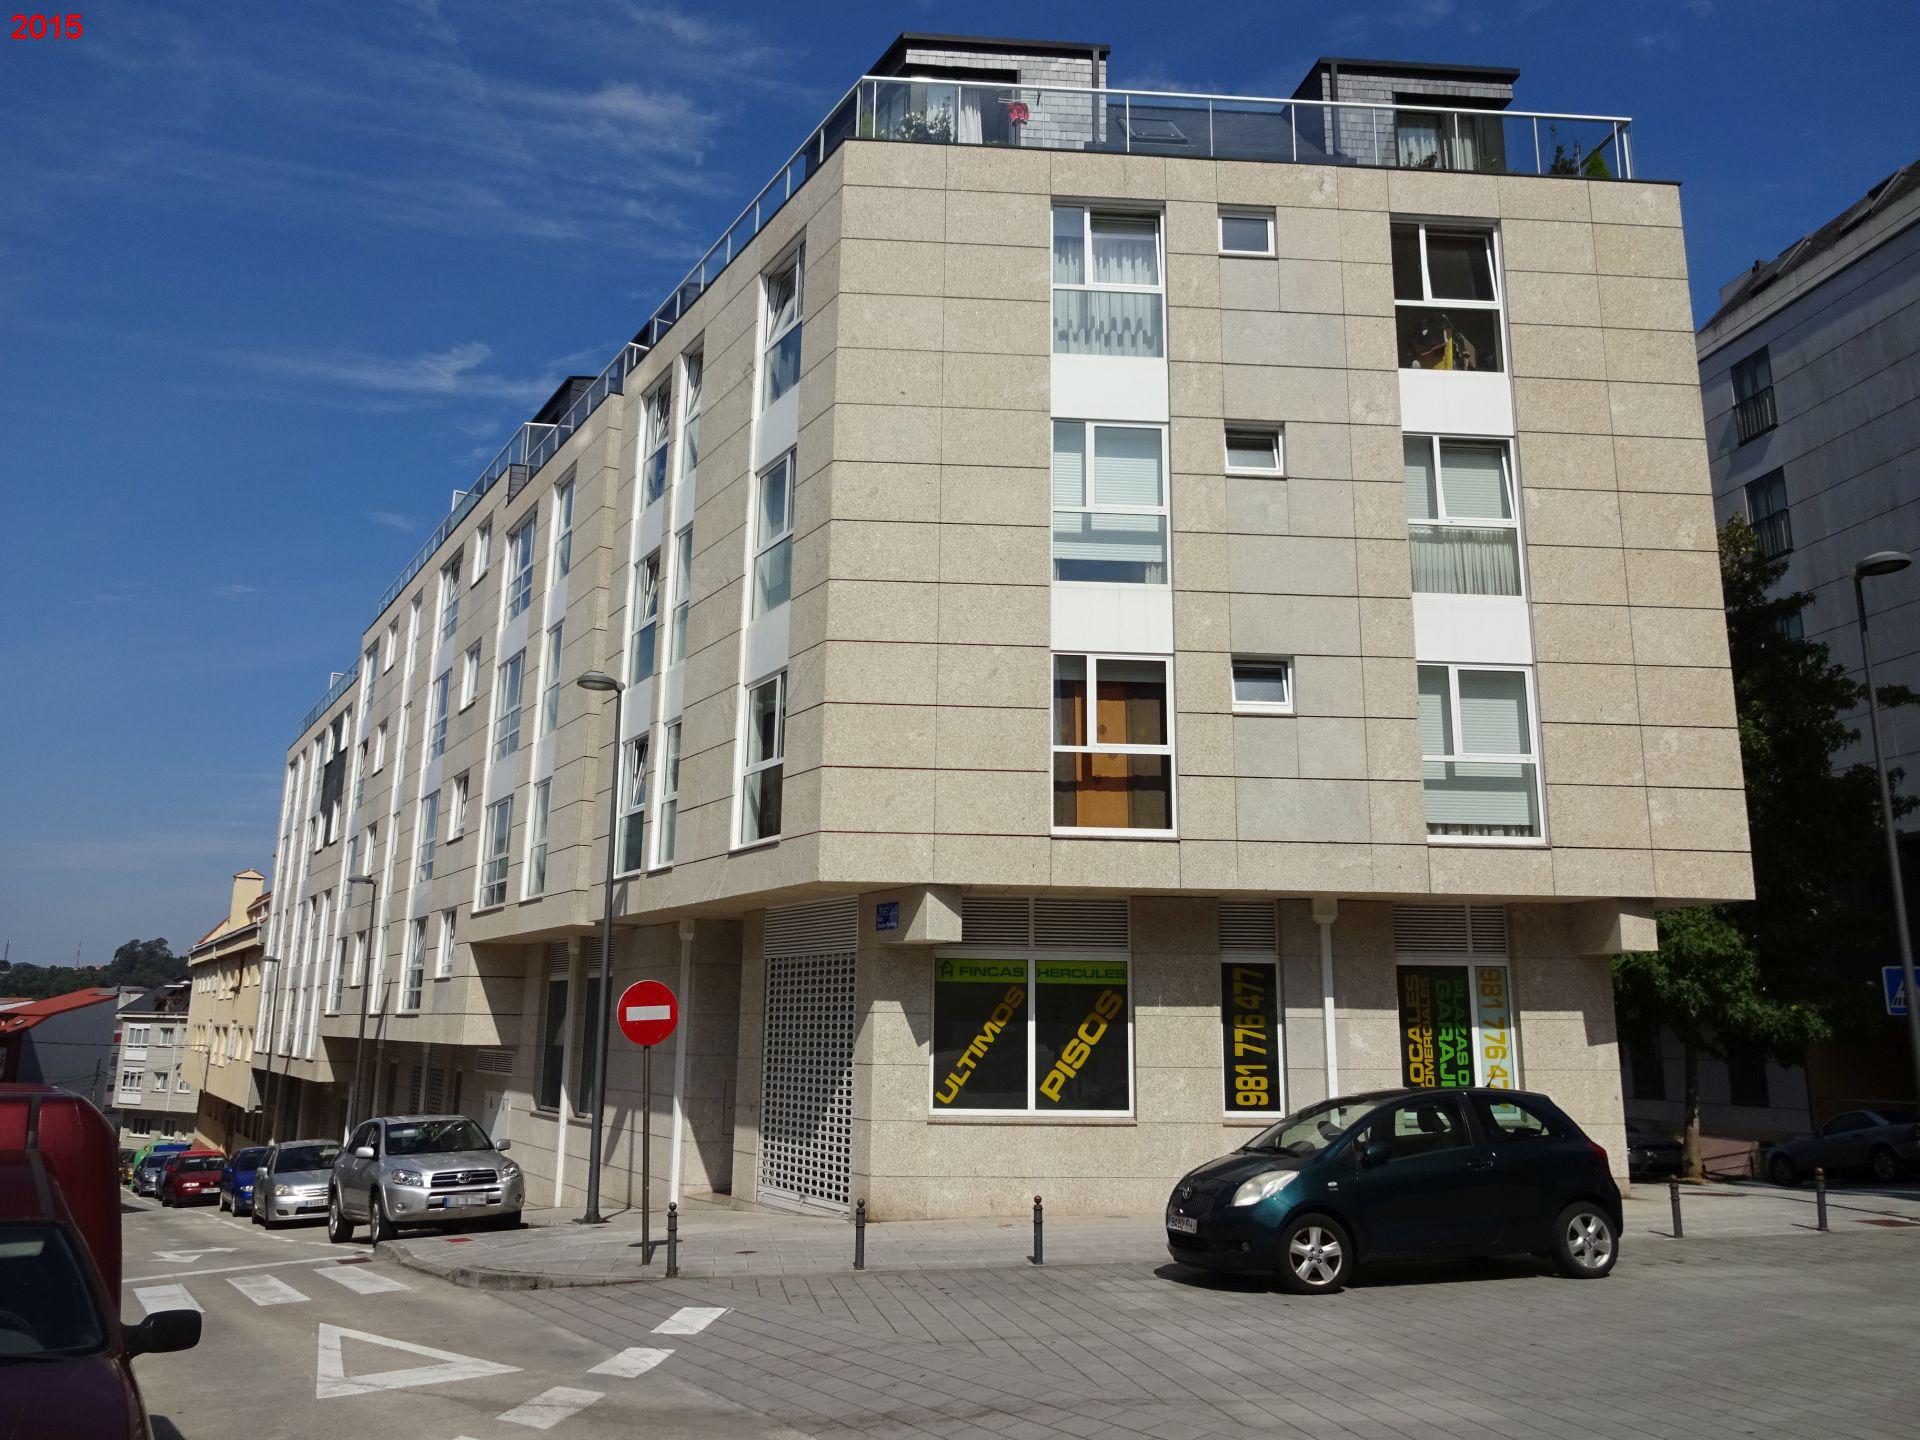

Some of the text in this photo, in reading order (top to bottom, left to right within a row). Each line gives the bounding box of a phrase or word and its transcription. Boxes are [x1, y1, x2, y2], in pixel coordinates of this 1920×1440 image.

[959, 966, 1126, 979] FINCAS HERCULES
[1481, 969, 1504, 1010] 981
[935, 986, 1026, 1105] ULTIMOS
[1039, 988, 1124, 1103] PISOS
[1235, 1065, 1269, 1106] 981
[1404, 974, 1426, 1088] OCALES
[1420, 976, 1436, 1088] OMERCIALES
[1453, 980, 1470, 1087] PLAZAS D
